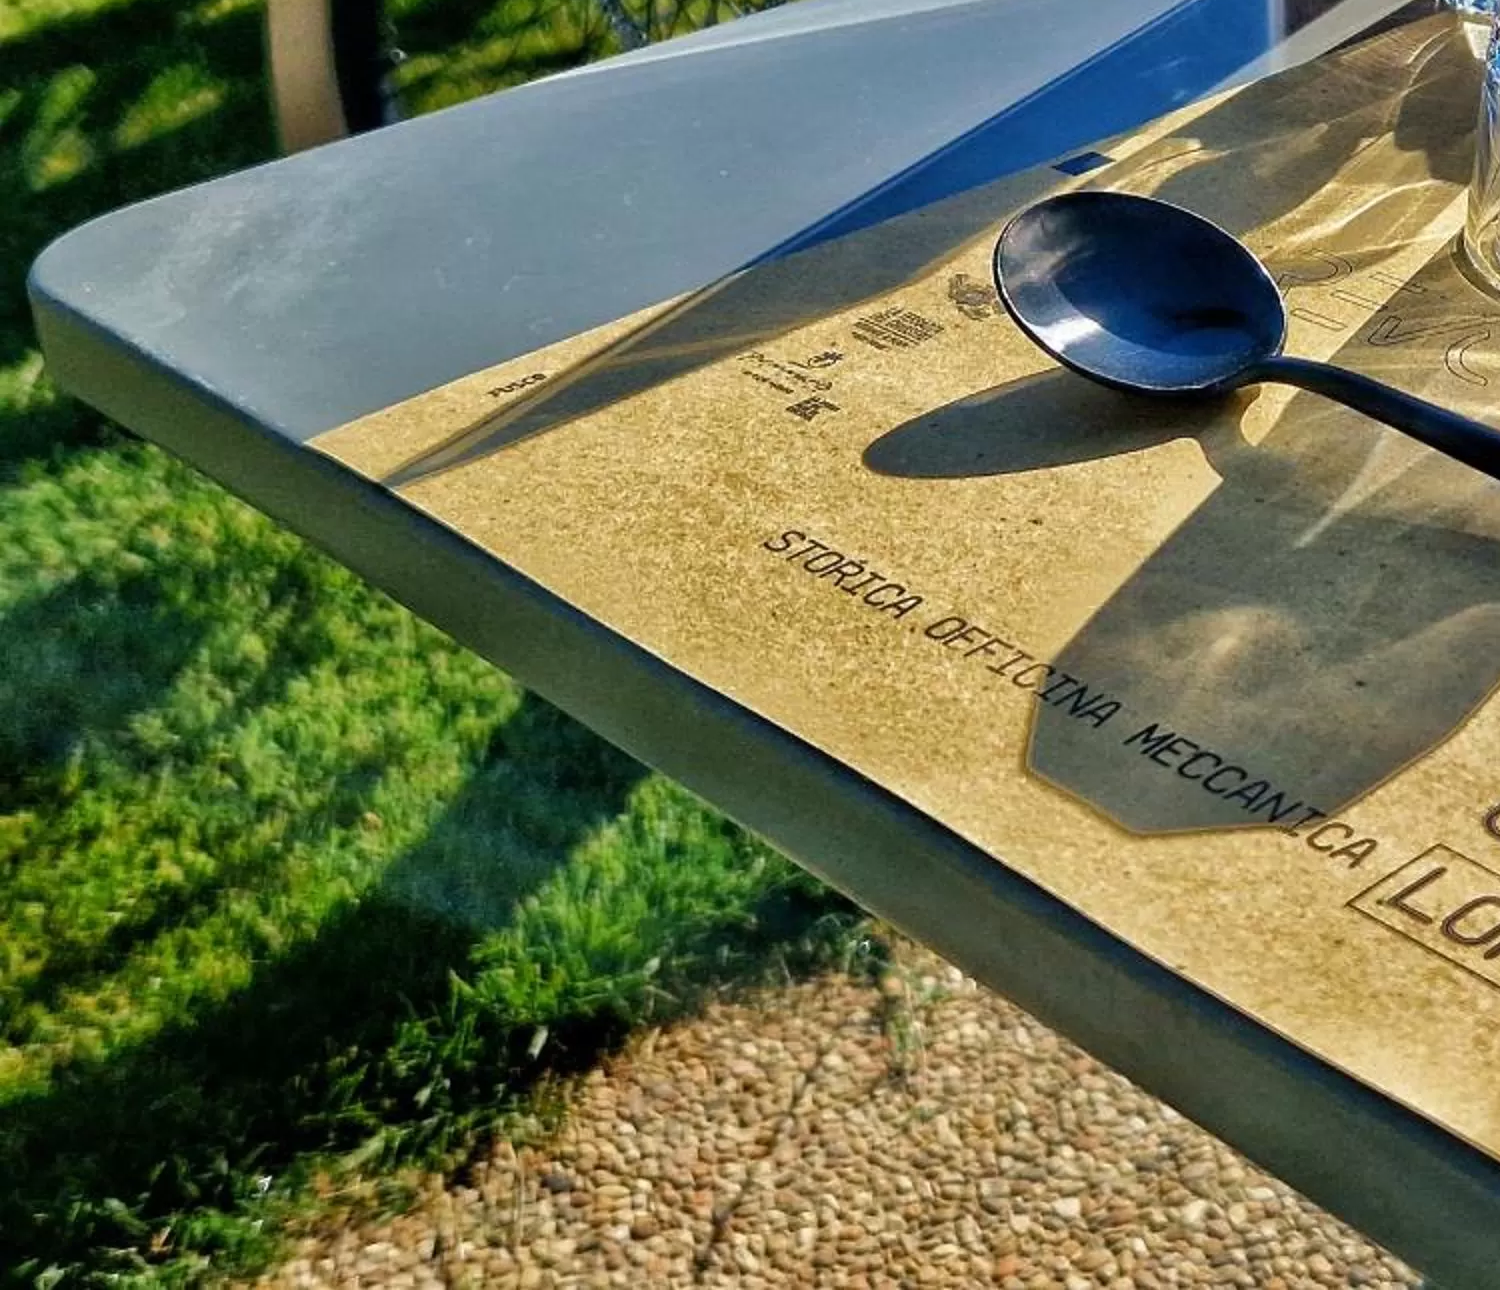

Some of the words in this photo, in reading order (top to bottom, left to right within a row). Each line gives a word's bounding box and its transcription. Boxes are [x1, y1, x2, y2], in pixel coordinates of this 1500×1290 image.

[763, 528, 925, 620] STORICA
[924, 615, 1122, 728] OFFICINA
[1124, 722, 1380, 870] MECCANICA
